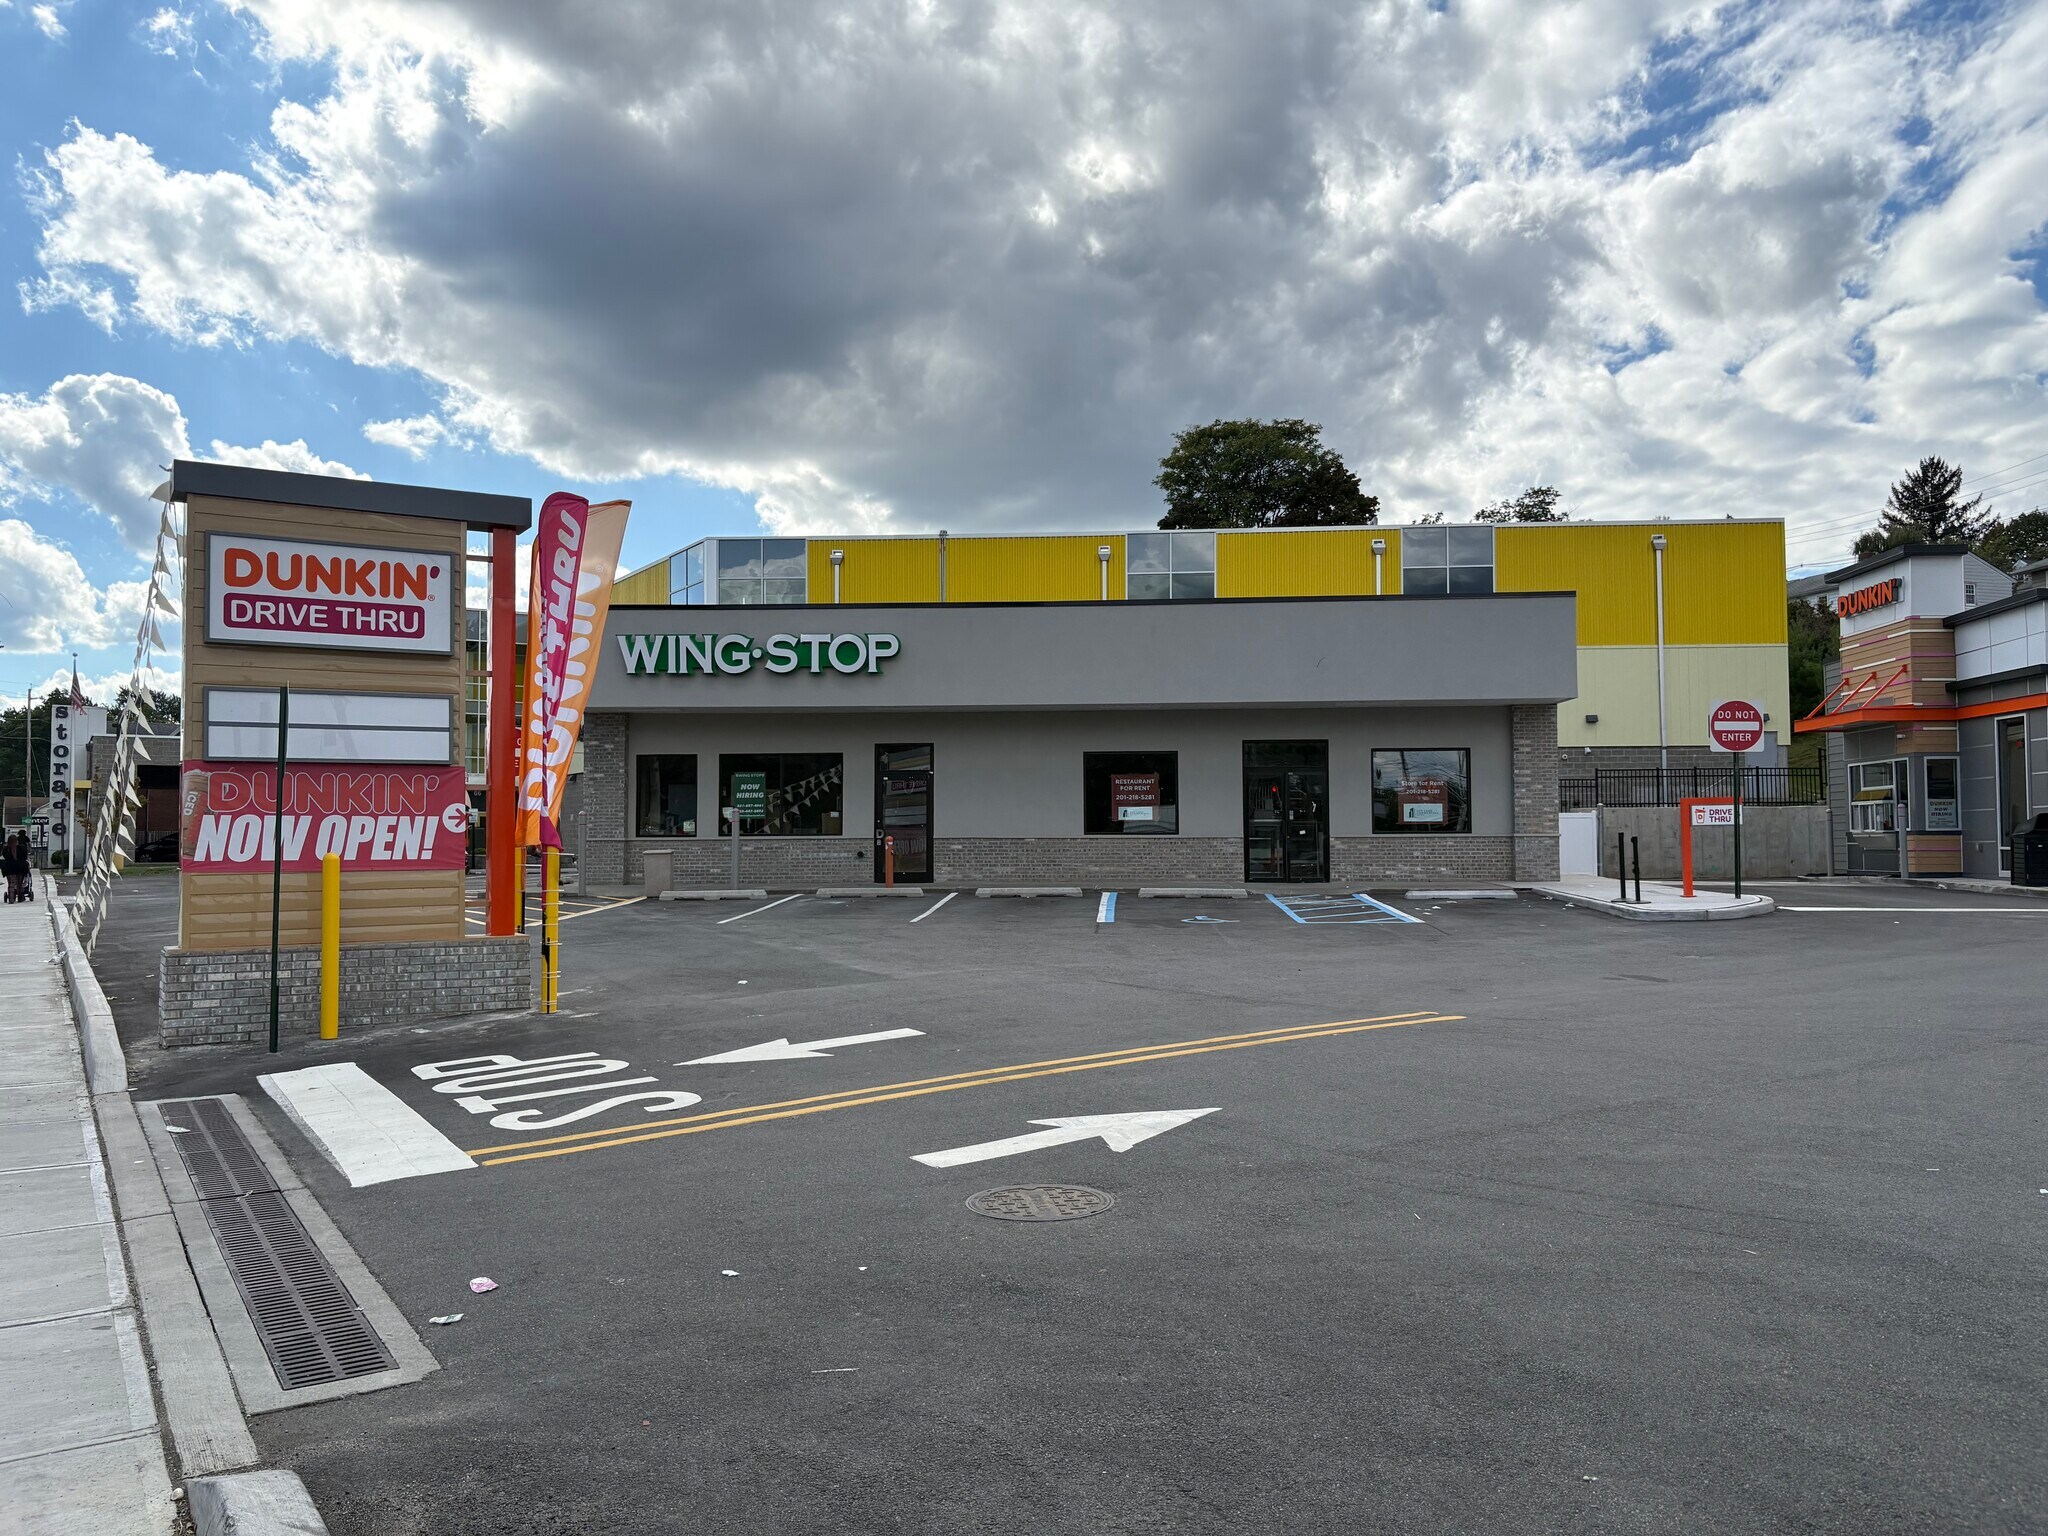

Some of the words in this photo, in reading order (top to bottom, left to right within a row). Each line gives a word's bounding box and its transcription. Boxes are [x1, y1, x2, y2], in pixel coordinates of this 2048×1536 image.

[224, 547, 441, 601] DUNKIN'
[230, 599, 328, 628] DRIVE
[335, 606, 419, 633] THRU
[1838, 579, 1897, 619] DUNKIN'
[1718, 711, 1731, 719] DO
[1735, 711, 1755, 719] NOT
[1722, 733, 1752, 741] ENTER
[184, 790, 198, 817] ICED
[207, 771, 440, 814] DUNKIN'
[194, 814, 313, 863] NOW
[315, 815, 440, 861] OPEN!
[410, 1051, 702, 1131] STOP
